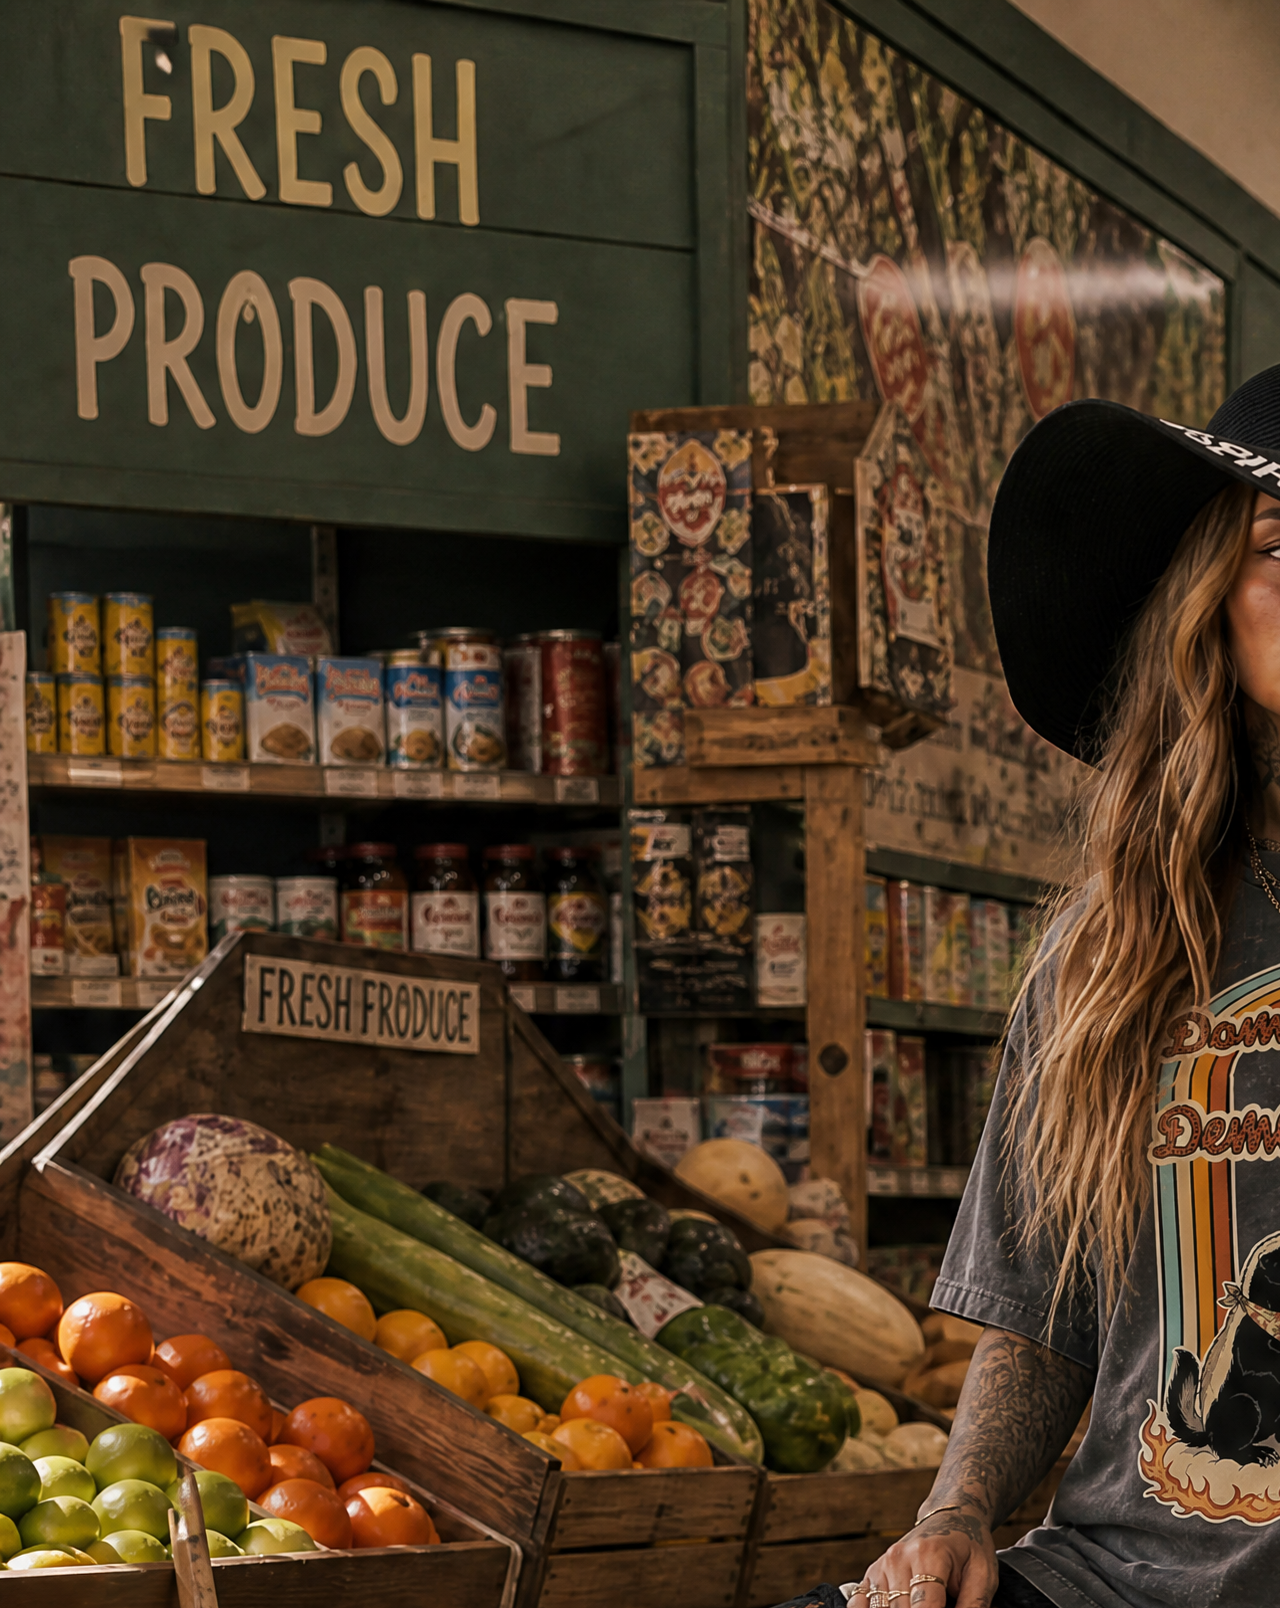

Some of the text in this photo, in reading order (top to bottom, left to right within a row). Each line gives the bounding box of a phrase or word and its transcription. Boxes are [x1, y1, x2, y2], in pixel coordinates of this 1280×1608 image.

[119, 16, 480, 226] FRESH
[69, 255, 560, 455] PRODUCE
[258, 966, 352, 1031] FRESH
